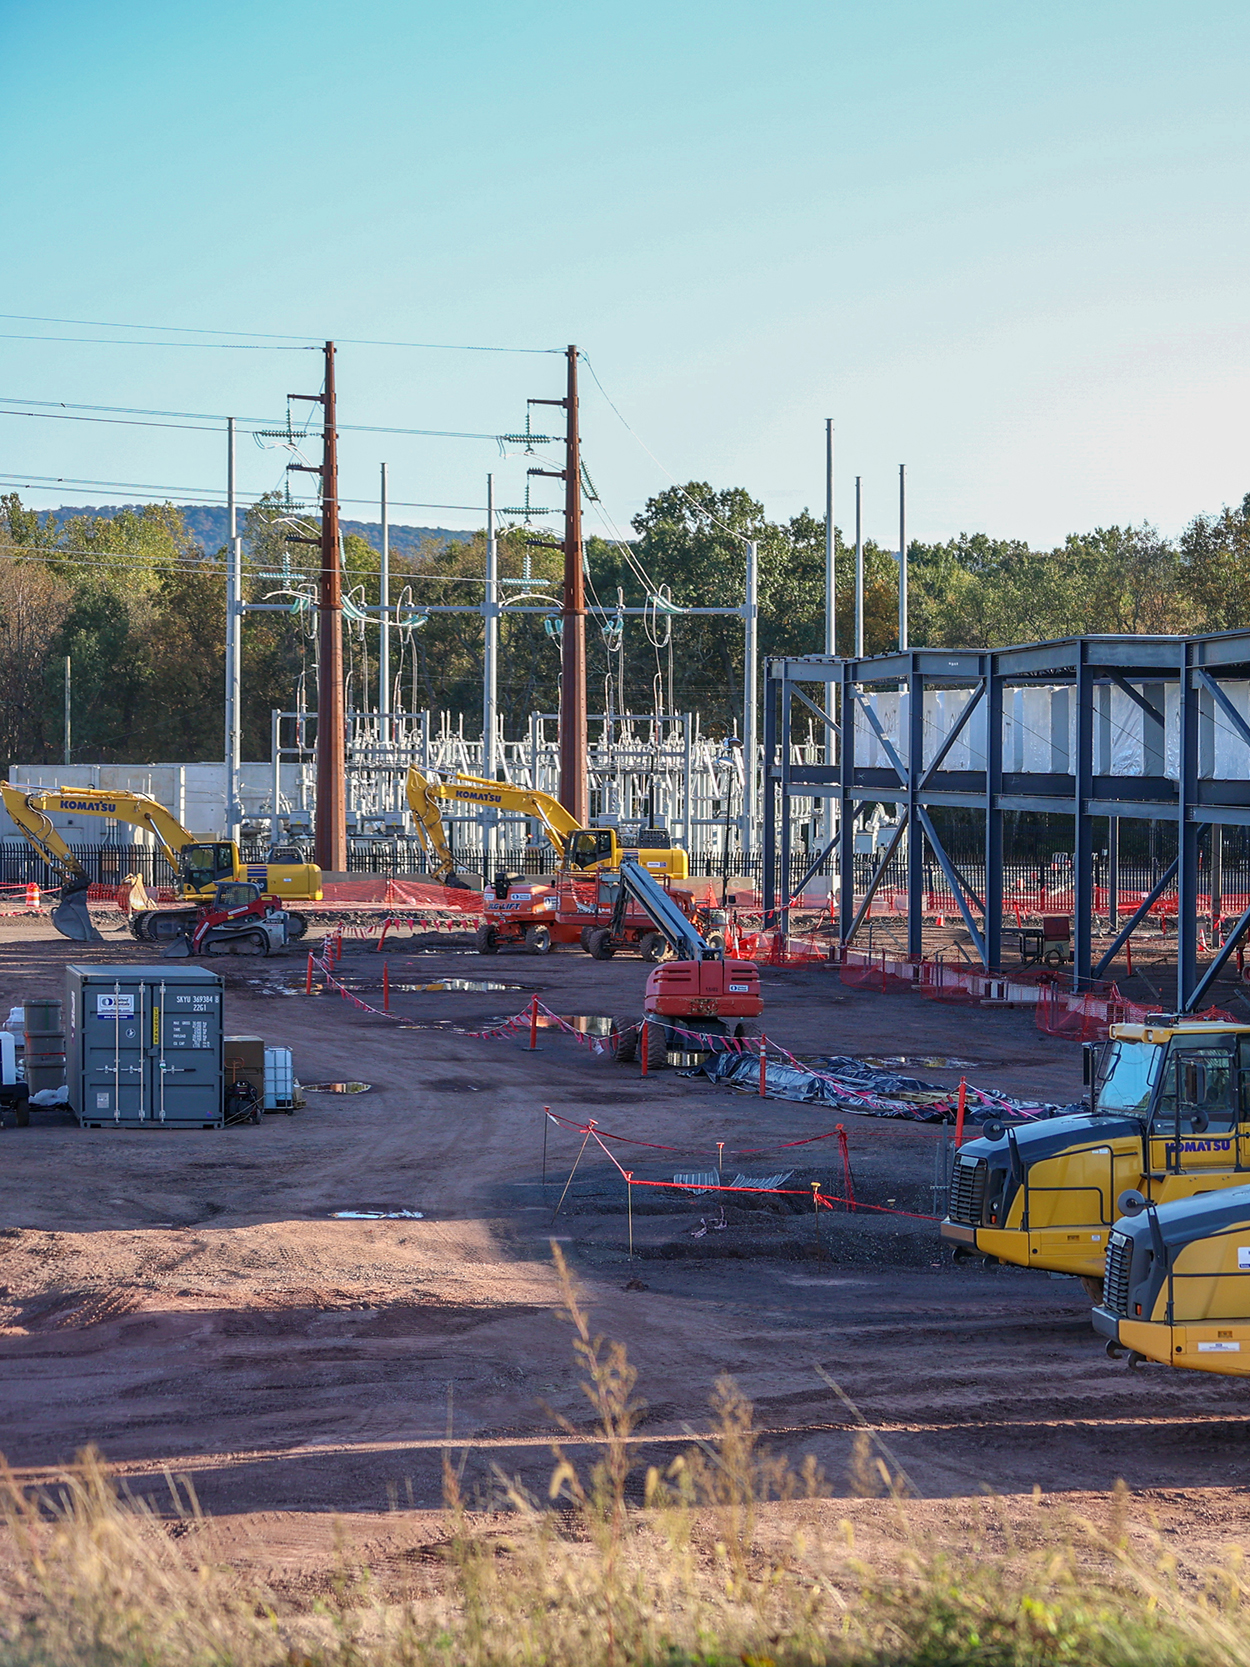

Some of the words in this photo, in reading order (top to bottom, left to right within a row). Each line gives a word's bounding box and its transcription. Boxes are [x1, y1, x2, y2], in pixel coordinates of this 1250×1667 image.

[455, 790, 502, 803] KOMATSU
[60, 800, 116, 813] KOMATSU
[176, 995, 191, 1003] SKYU
[192, 995, 213, 1003] 369384
